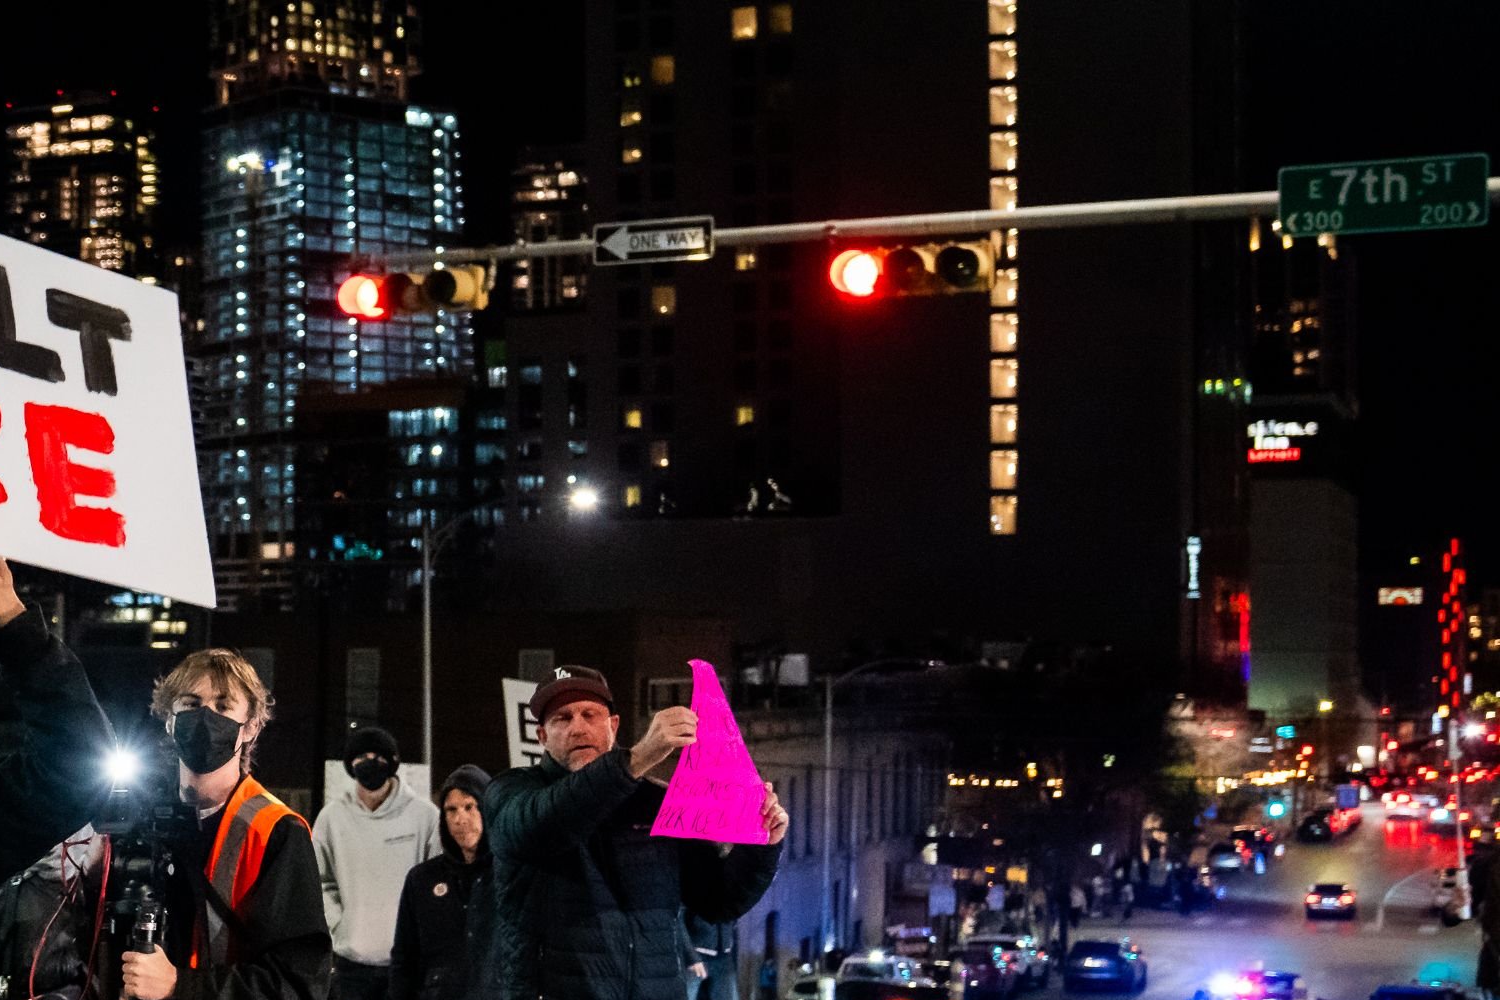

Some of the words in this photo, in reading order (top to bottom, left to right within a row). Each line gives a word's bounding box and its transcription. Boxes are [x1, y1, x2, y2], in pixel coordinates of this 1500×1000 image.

[1309, 179, 1322, 199] E
[1330, 167, 1408, 205] 7th
[1422, 162, 1455, 184] ST
[1303, 211, 1343, 231] 300
[1420, 203, 1463, 224] 200
[629, 233, 660, 250] ONE
[666, 230, 700, 246] WAY
